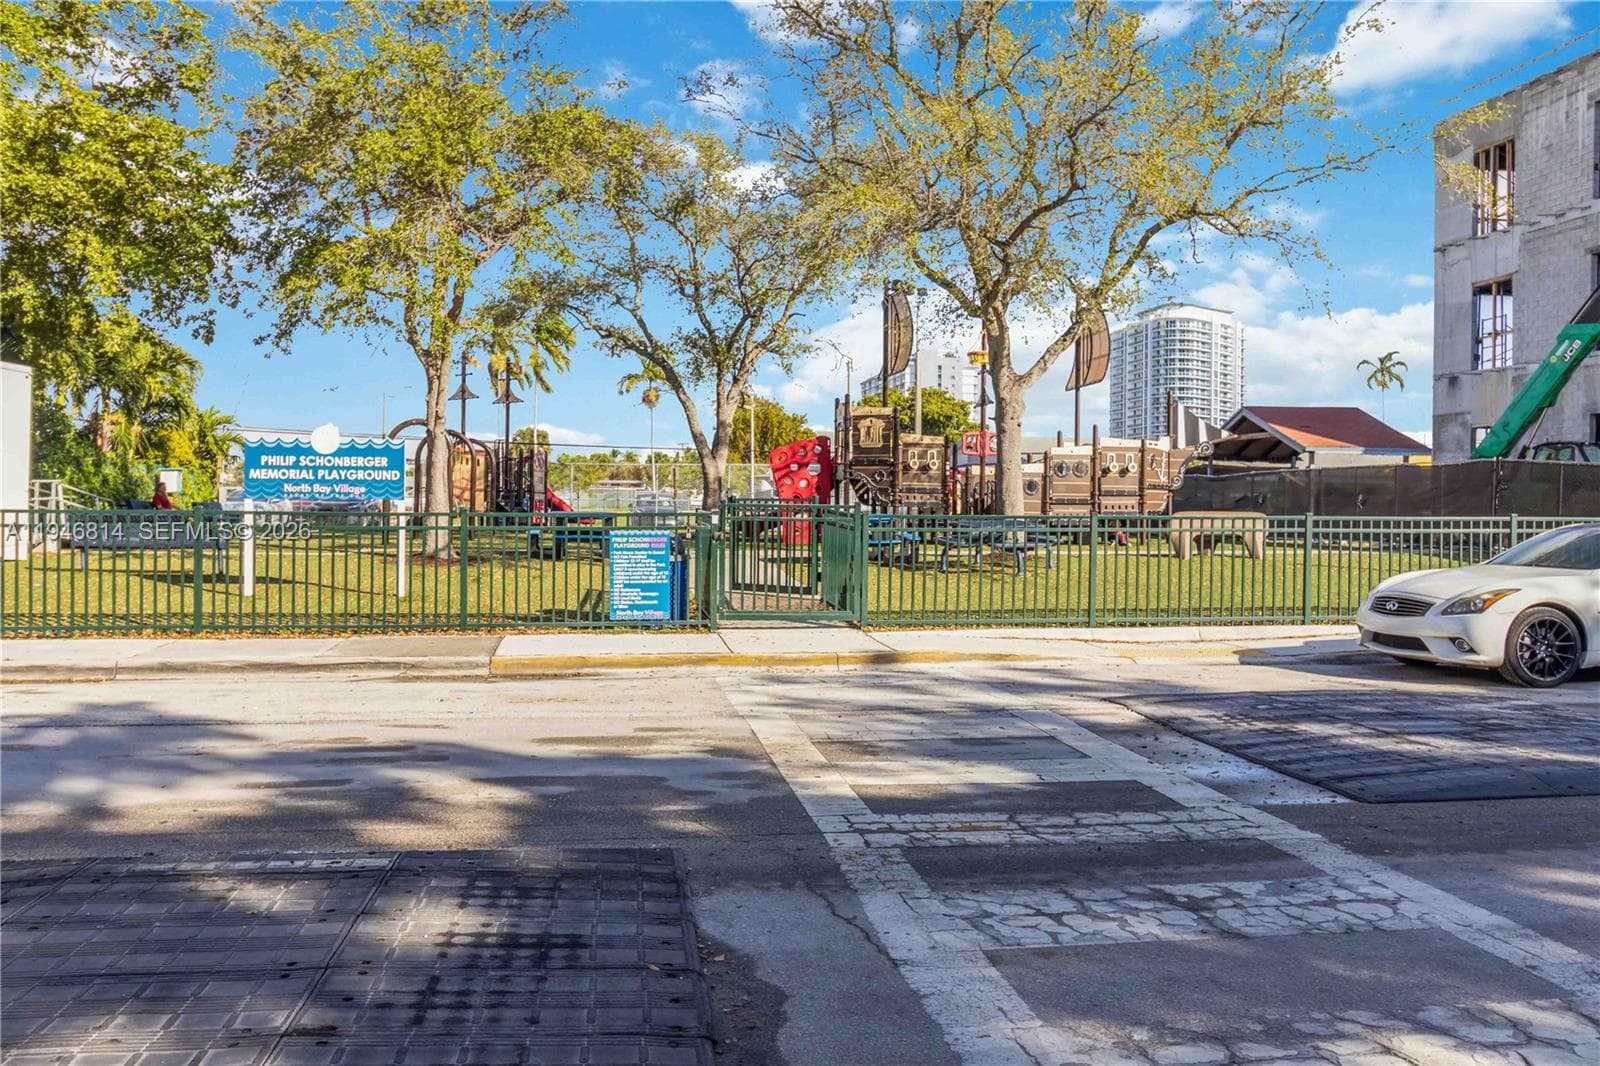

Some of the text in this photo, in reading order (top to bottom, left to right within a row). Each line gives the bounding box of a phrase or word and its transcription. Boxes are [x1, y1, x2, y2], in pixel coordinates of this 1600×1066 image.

[261, 456, 388, 467] PHILIP SCHONBERGER
[249, 469, 400, 481] MEMORIAL PLAYGROUND
[284, 484, 366, 495] North Bay Village
